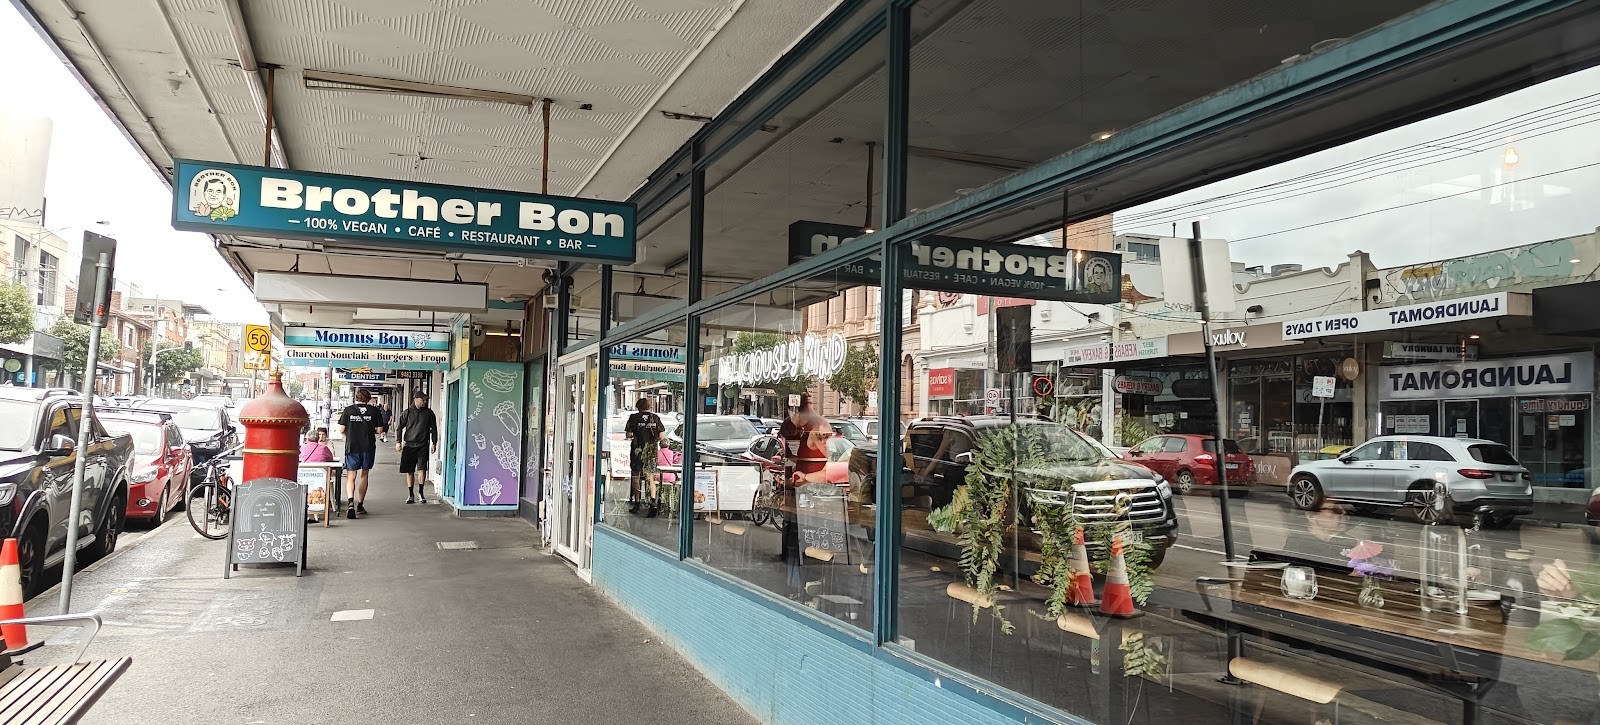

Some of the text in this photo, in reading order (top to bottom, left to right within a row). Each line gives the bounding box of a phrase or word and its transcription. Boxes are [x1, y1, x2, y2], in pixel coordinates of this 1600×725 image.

[260, 177, 625, 238] Brother Bon
[303, 217, 583, 250] 100% VEGAN CAFÉ RESTAURANT BAR
[251, 333, 268, 346] 50
[314, 329, 409, 349] Momus Boy
[286, 349, 447, 364] Charcoal Souvlaki Burgers Froyo
[718, 333, 847, 386] DELICIOUSLY KIND
